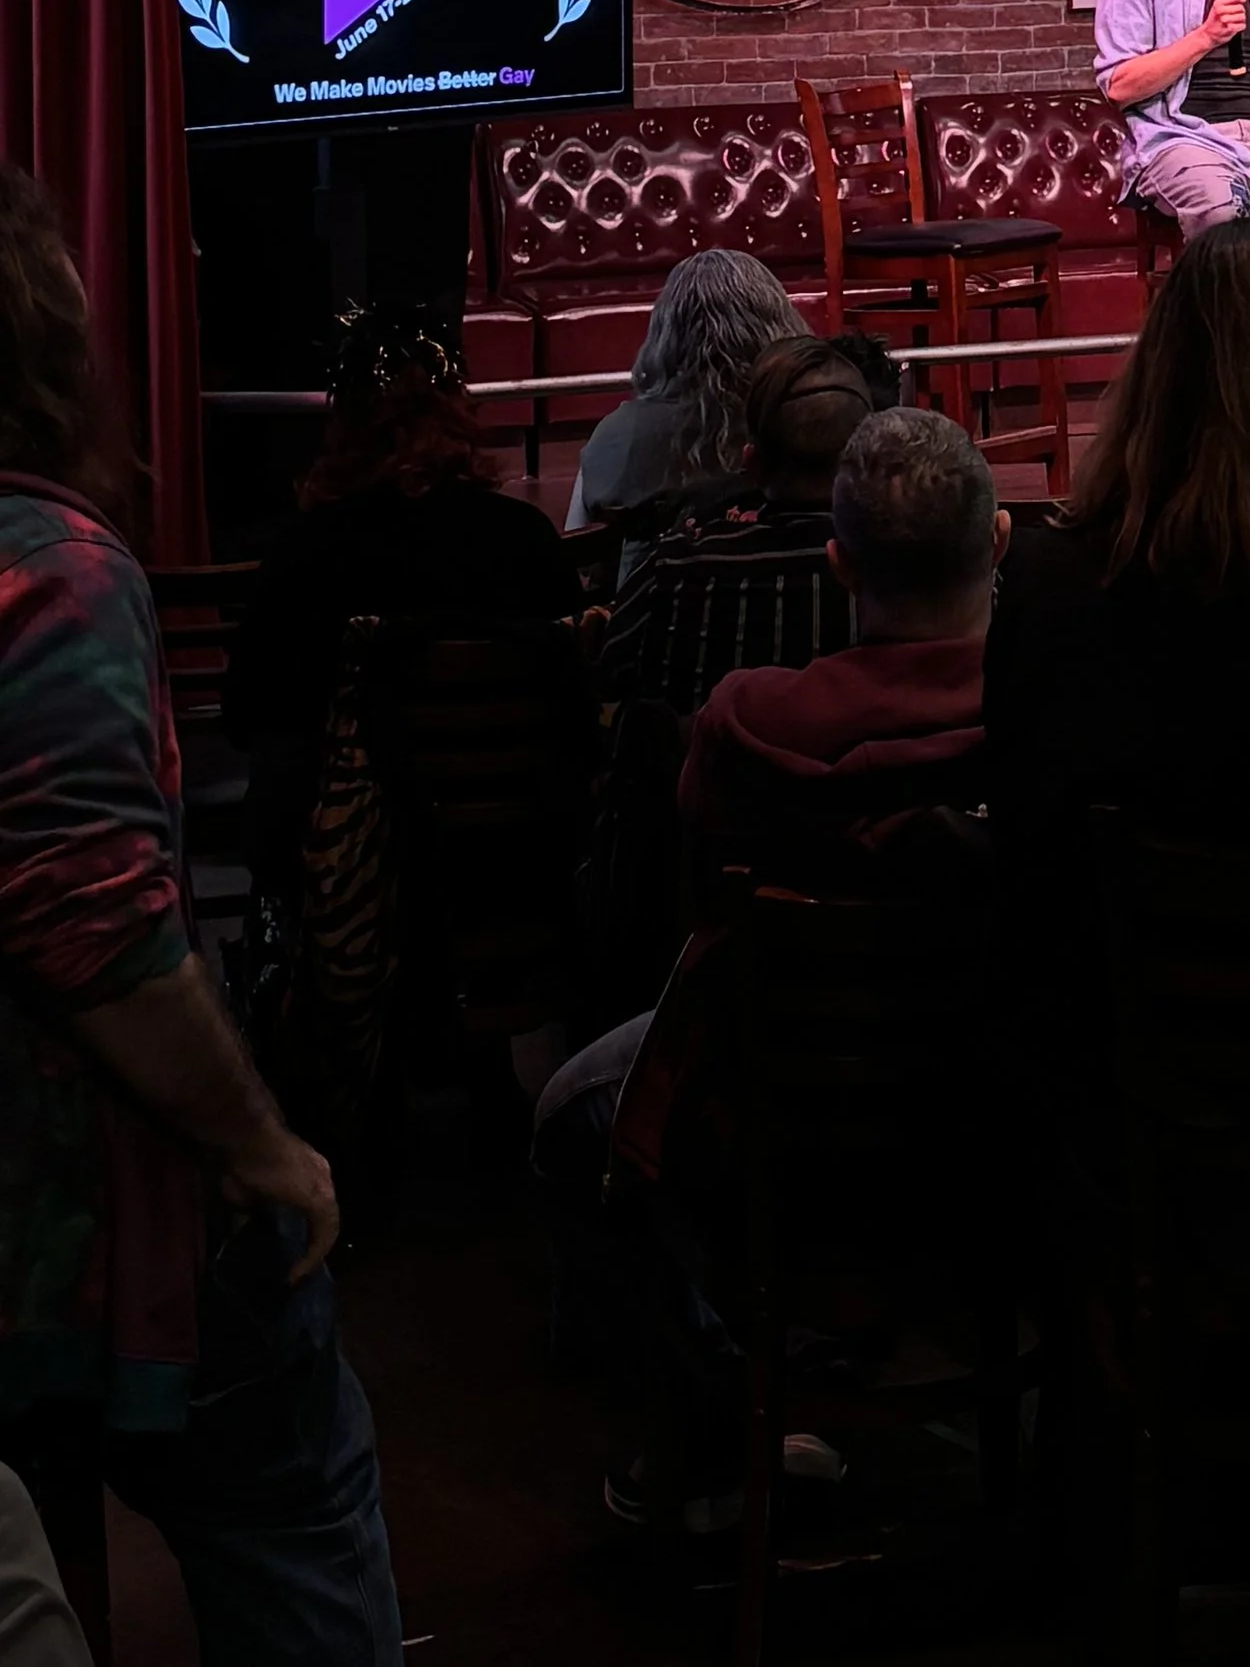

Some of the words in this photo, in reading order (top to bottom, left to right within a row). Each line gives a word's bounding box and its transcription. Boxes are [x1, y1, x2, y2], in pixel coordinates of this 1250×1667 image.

[335, 18, 378, 60] June
[274, 84, 306, 103] We
[310, 80, 363, 101] Make
[367, 74, 436, 96] Movies
[437, 70, 497, 90] Better
[499, 66, 535, 87] Gay
